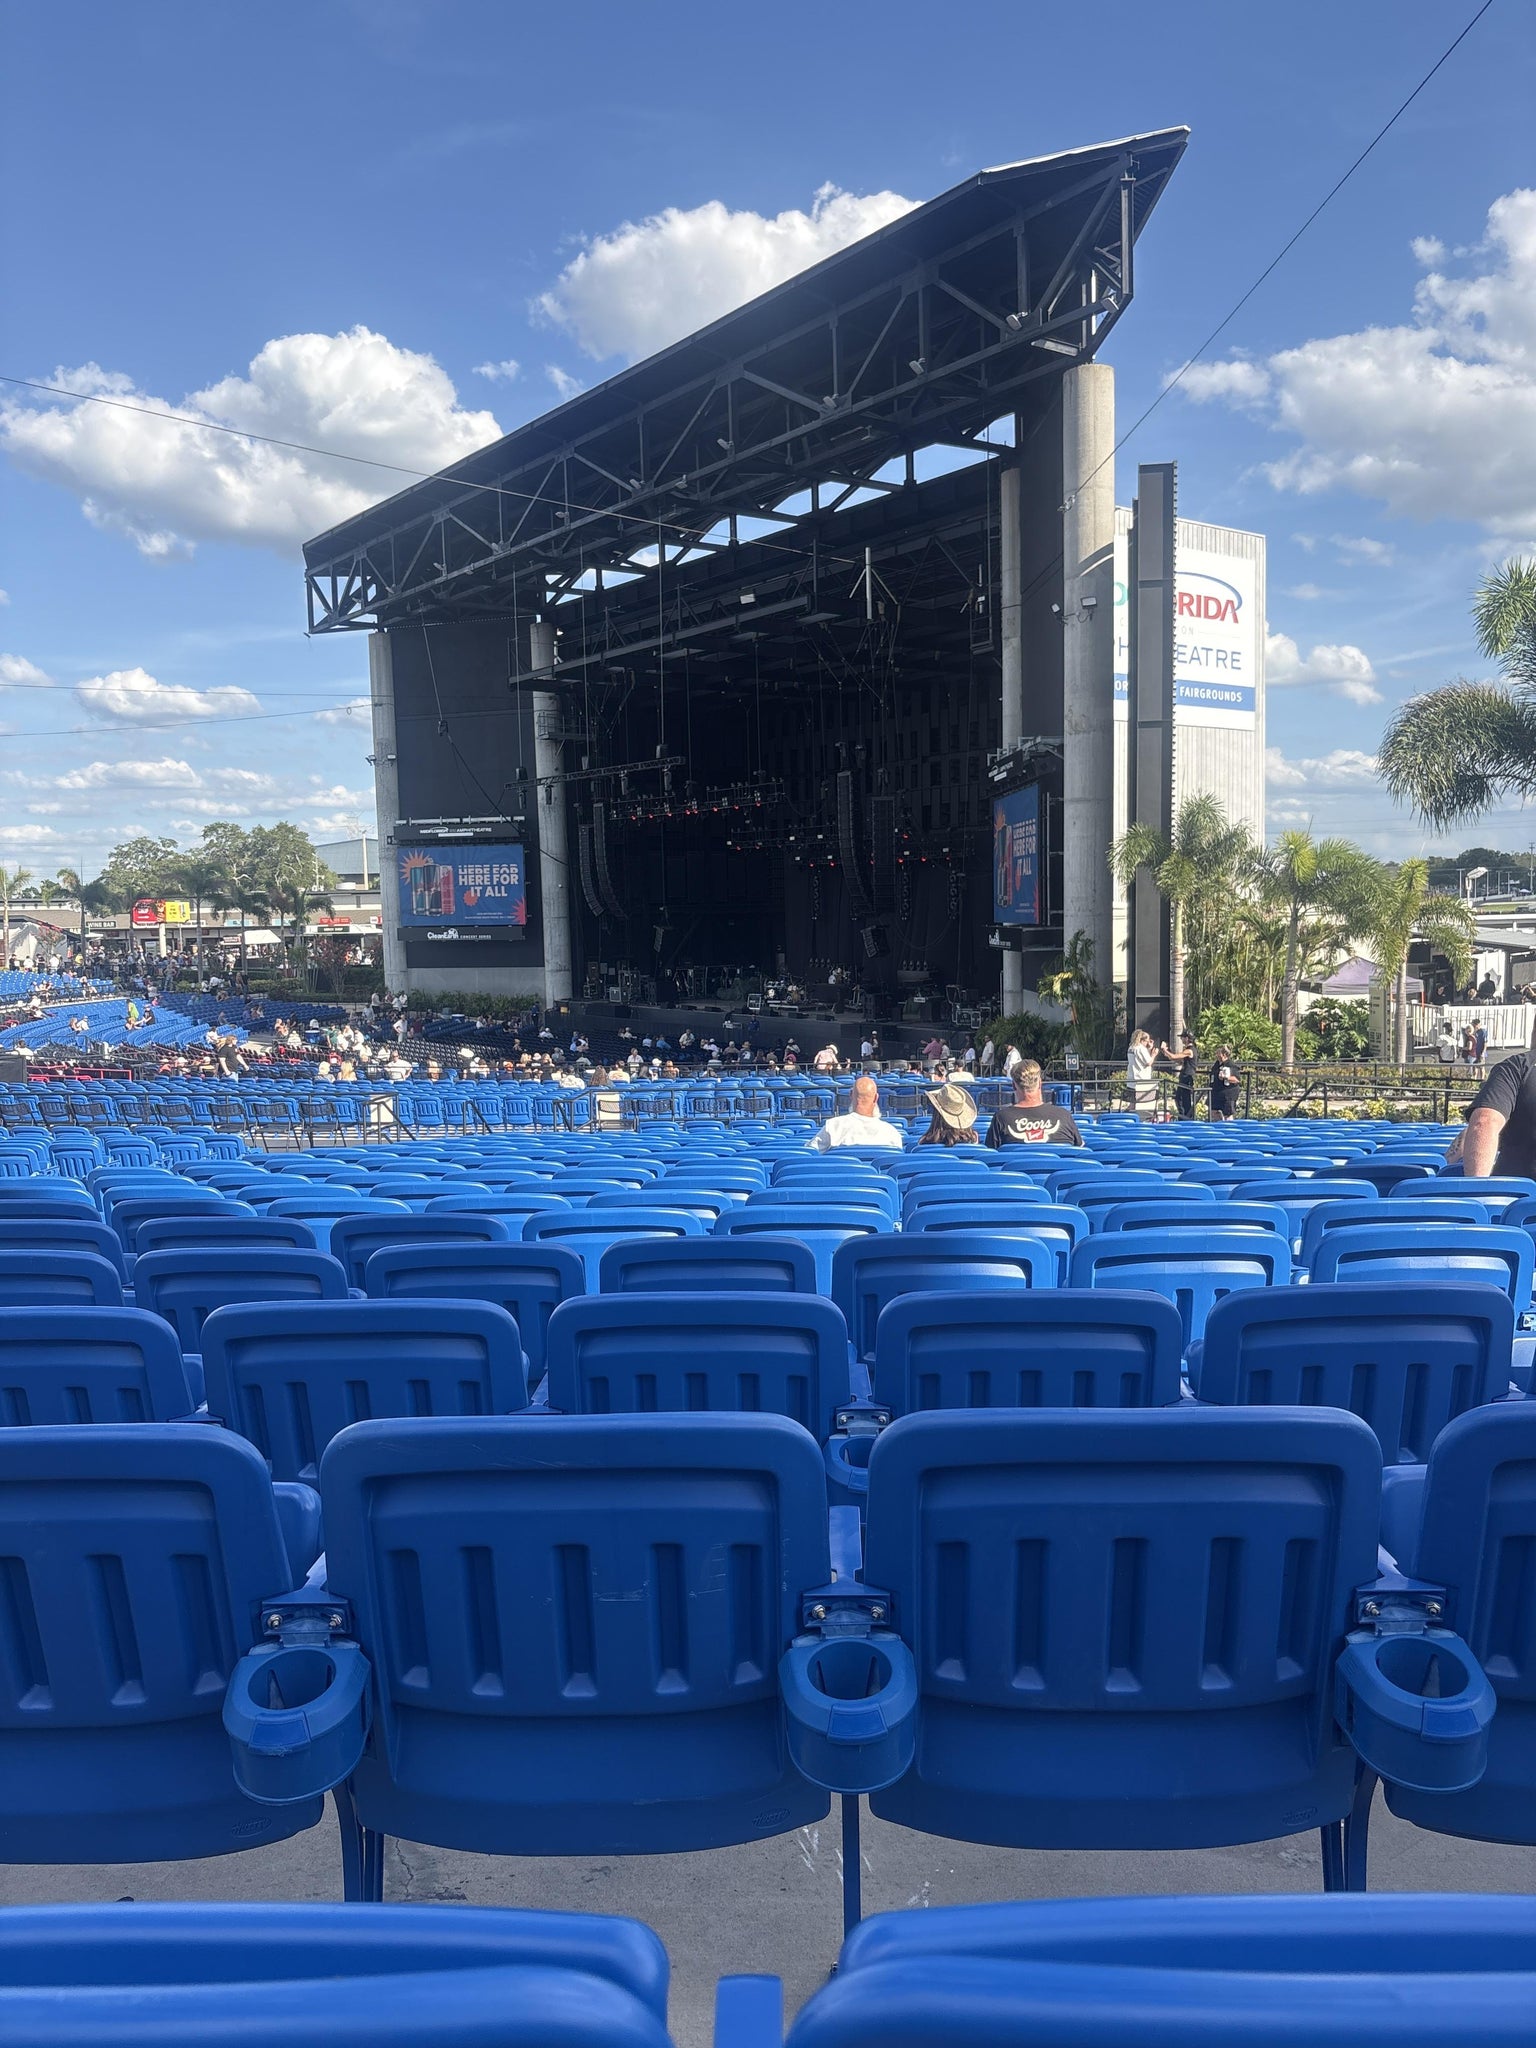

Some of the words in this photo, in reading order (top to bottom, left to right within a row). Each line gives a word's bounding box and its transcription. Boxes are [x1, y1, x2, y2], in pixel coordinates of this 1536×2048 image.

[1178, 591, 1239, 624] RIDA
[1176, 644, 1242, 670] EATRE
[1115, 681, 1128, 692] OR
[1180, 686, 1243, 702] FAIRGROUNDS
[458, 874, 490, 885] HERE
[493, 874, 518, 885] FOR
[470, 886, 482, 897] IT
[485, 886, 508, 897] ALL
[1015, 1117, 1053, 1131] Coors
